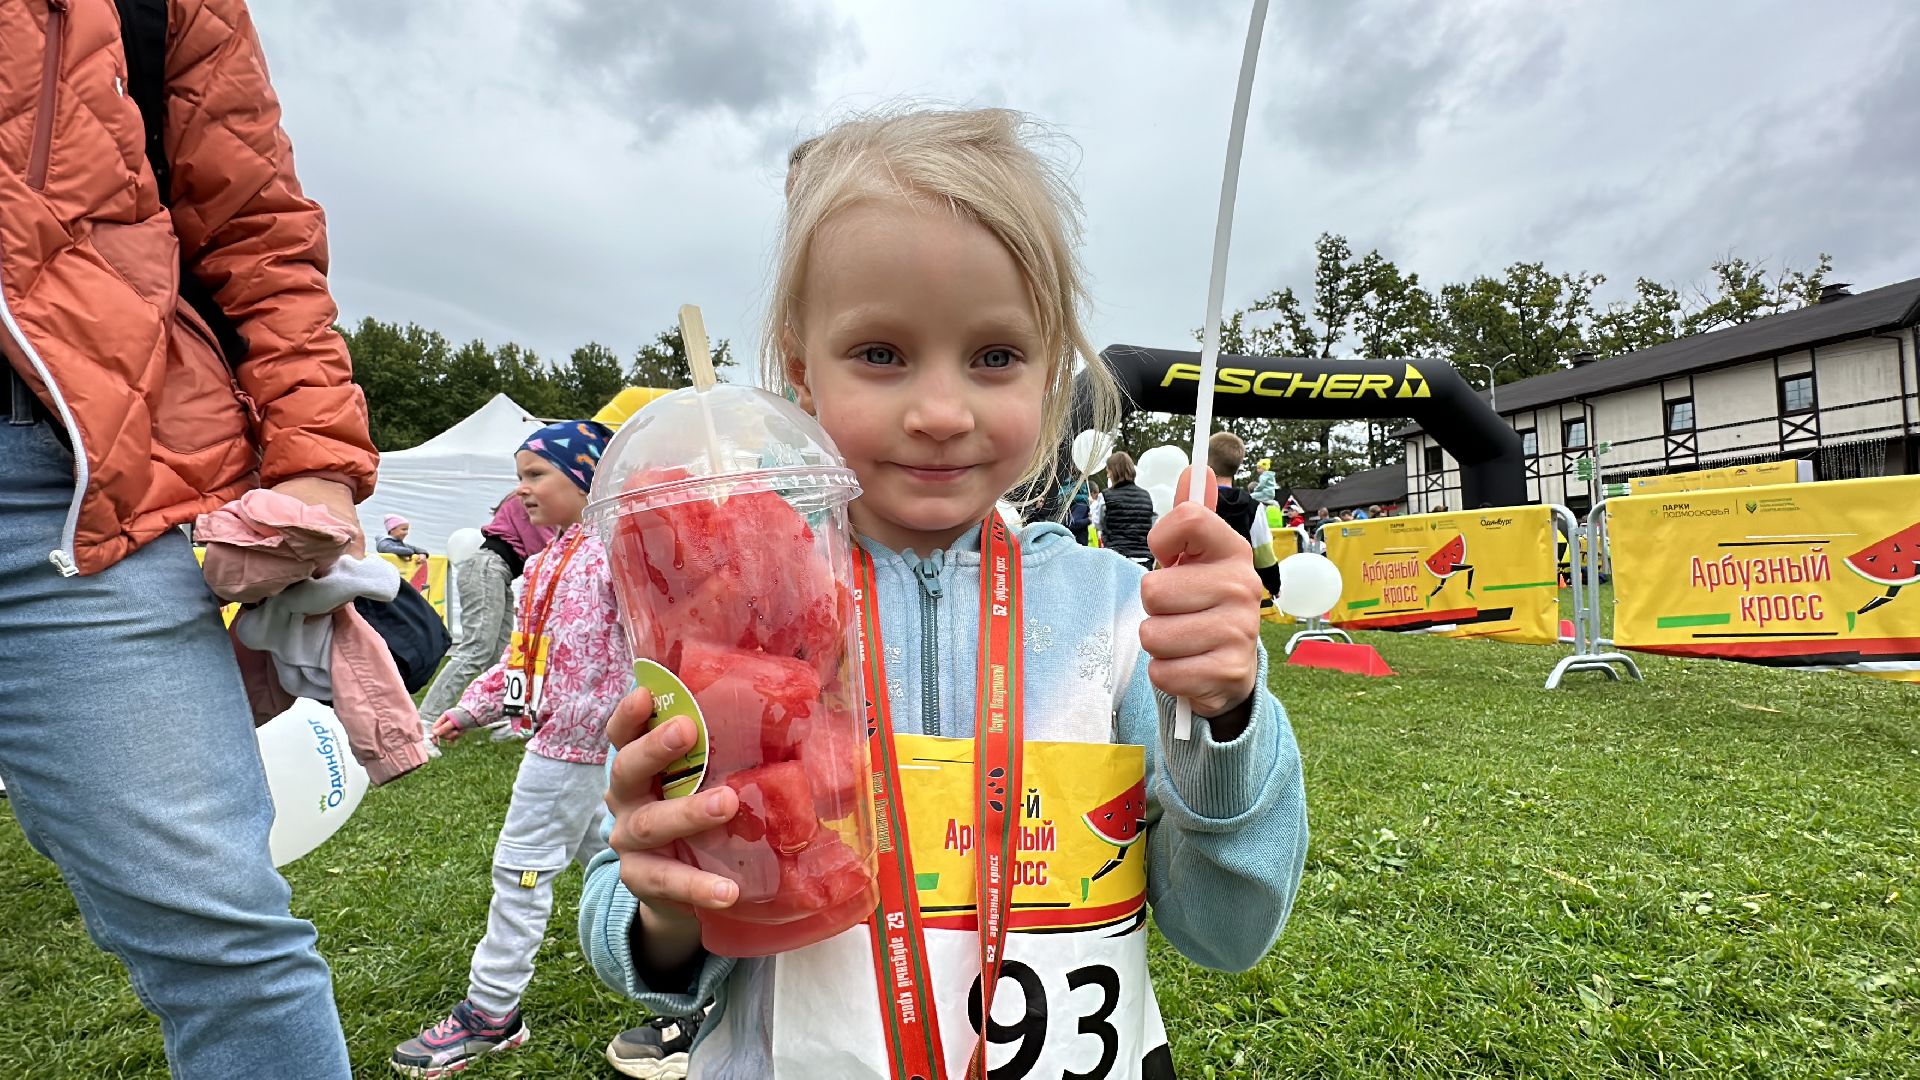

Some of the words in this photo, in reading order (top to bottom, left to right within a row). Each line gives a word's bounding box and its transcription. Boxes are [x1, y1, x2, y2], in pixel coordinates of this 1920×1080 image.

[1160, 363, 1394, 399] FSCHER
[1662, 503, 1690, 511] ПАРКИ
[1362, 556, 1420, 585] Арбузный
[1691, 547, 1831, 592] Арбузный
[1383, 585, 1418, 608] кросс
[1740, 594, 1824, 628] кросс
[308, 719, 344, 808] Одинбург
[990, 854, 1000, 883] кросс
[1012, 860, 1048, 886] осс
[886, 911, 905, 931] 52
[989, 888, 999, 938] арбузный
[889, 936, 913, 987] арбузный
[986, 945, 996, 963] 52
[896, 991, 916, 1025] кросс
[967, 959, 1121, 1080] 93
